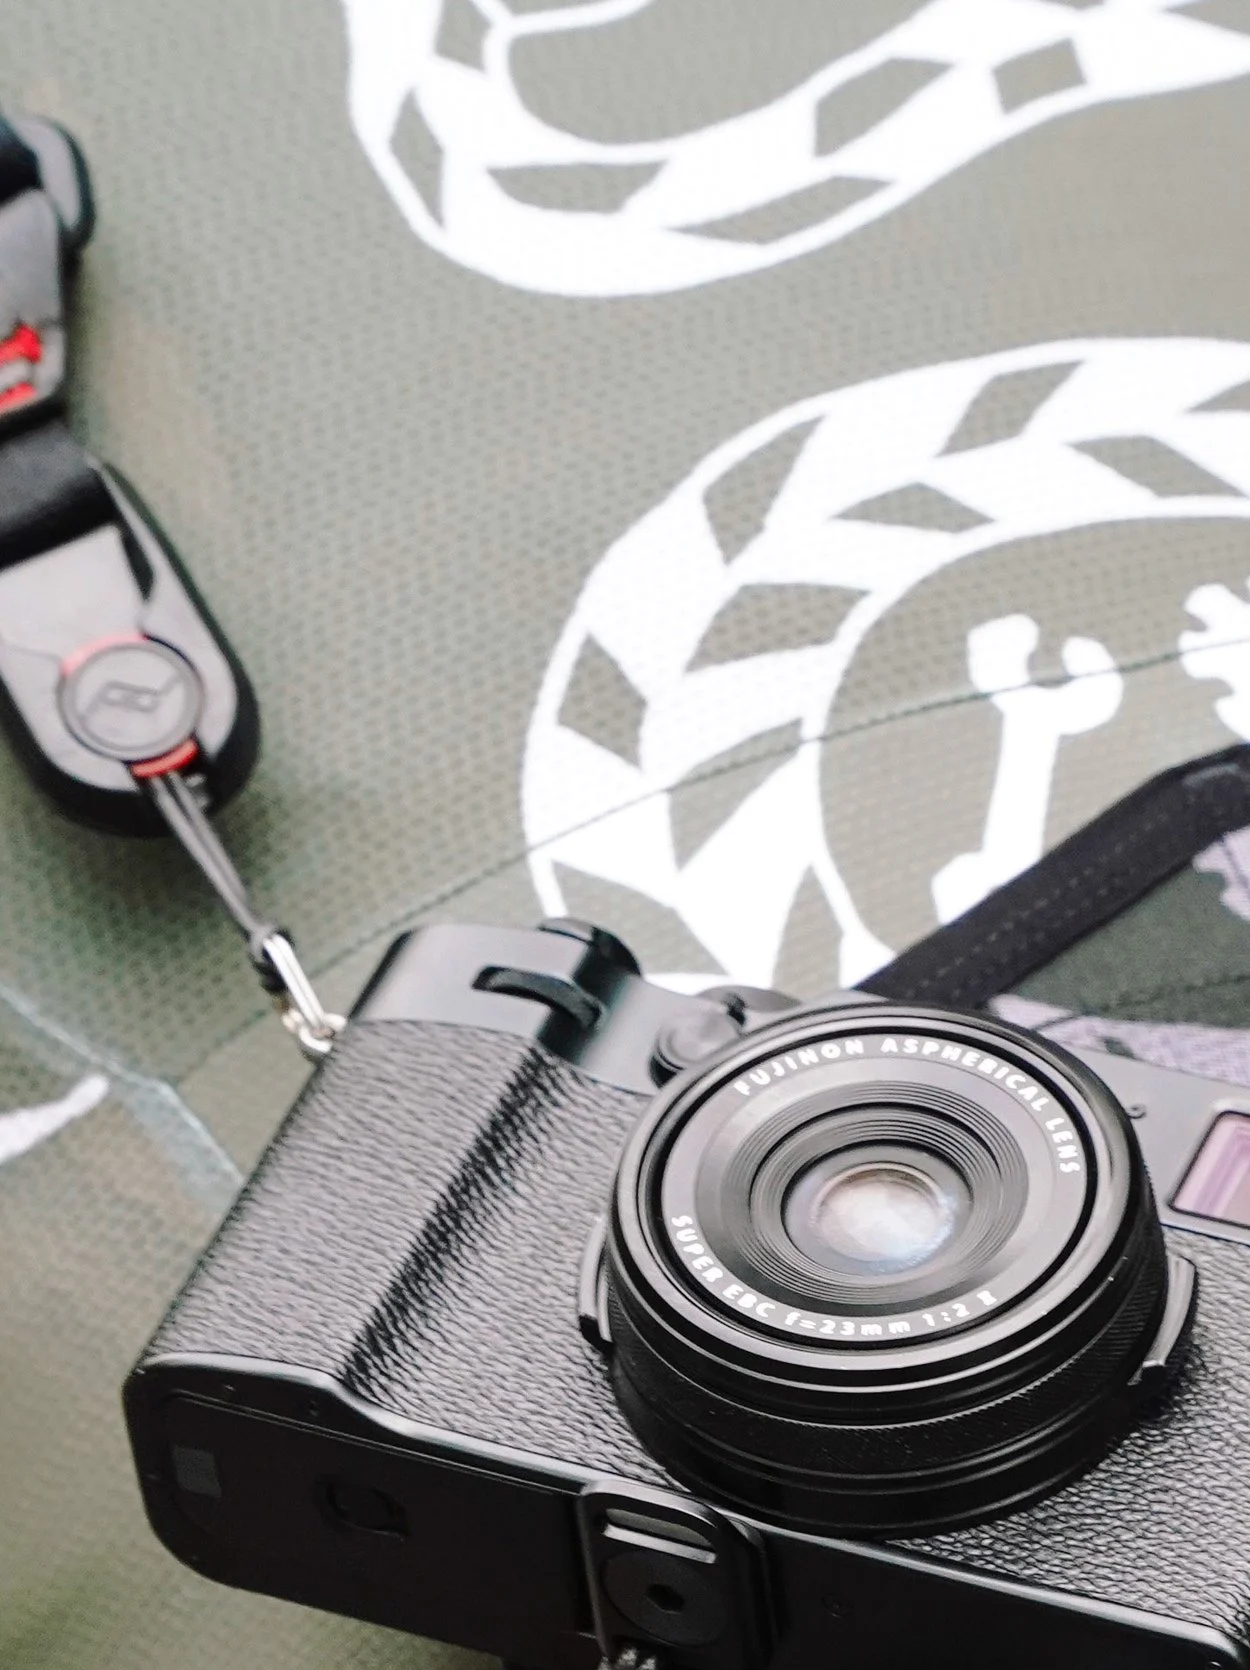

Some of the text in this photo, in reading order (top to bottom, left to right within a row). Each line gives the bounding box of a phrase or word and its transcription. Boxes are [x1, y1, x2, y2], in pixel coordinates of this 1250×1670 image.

[733, 1037, 1081, 1174] FUJINON ASPHERICAL LENS
[671, 1215, 724, 1283] SUPER
[722, 1283, 776, 1318] EBC
